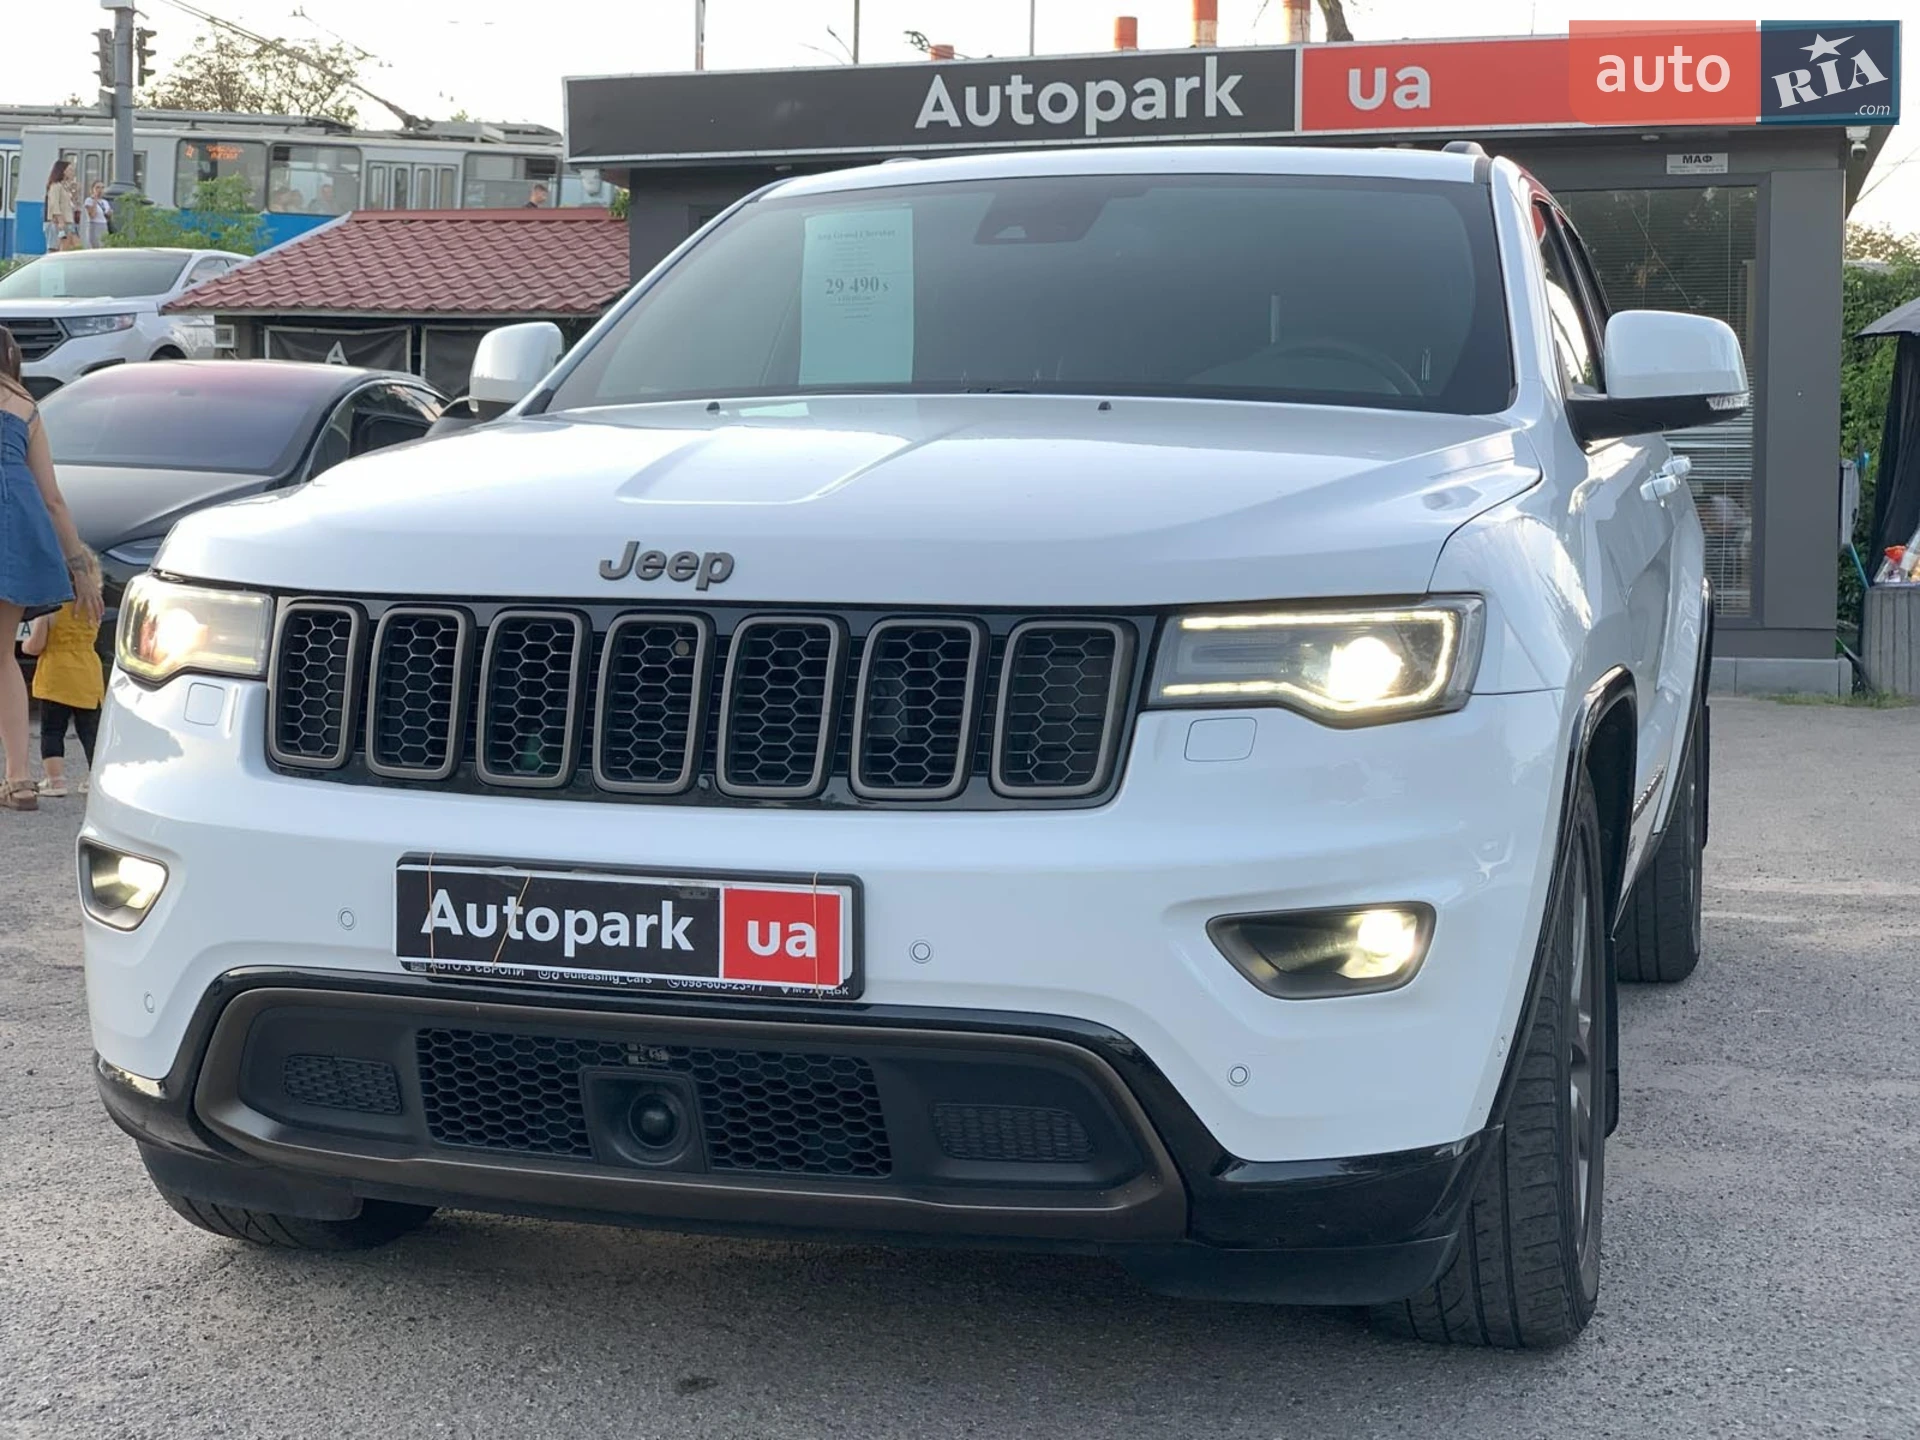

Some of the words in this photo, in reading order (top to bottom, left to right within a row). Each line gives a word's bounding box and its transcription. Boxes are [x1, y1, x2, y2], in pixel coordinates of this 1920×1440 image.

[915, 56, 1243, 135] Autopark
[1349, 65, 1431, 110] ua
[825, 277, 845, 294] 29
[849, 276, 879, 293] 490
[599, 540, 735, 591] Jeep
[421, 887, 696, 958] Autopark
[747, 919, 817, 960] ua
